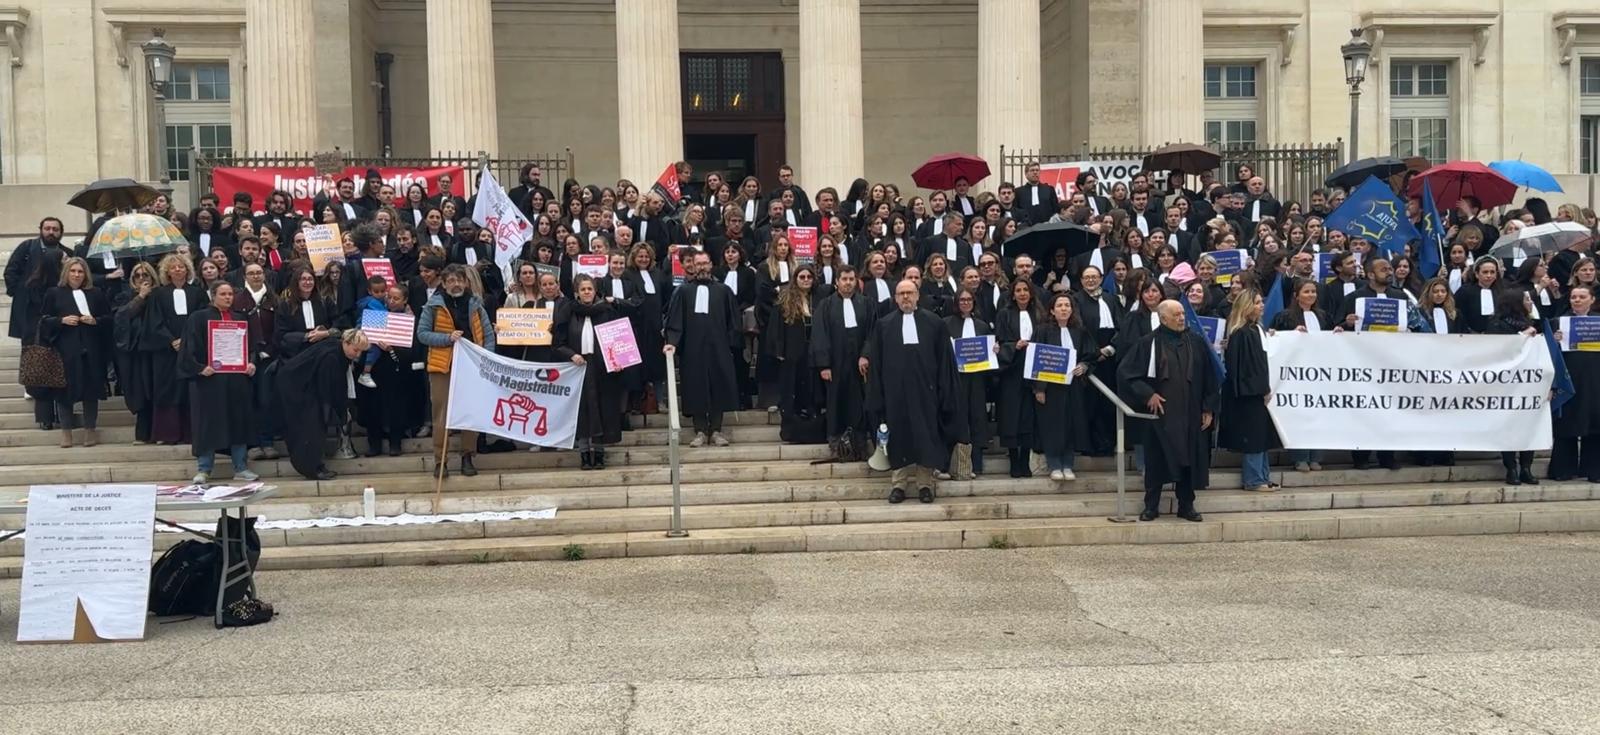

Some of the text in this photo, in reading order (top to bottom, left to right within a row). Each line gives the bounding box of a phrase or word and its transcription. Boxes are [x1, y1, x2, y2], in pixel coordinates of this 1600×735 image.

[480, 355, 534, 379] Syndicat
[1280, 366, 1543, 384] UNION DES JEUNES AVOCATS
[499, 375, 571, 397] Magistrature
[1276, 393, 1541, 410] DU BARREAU DE MARSEILLE
